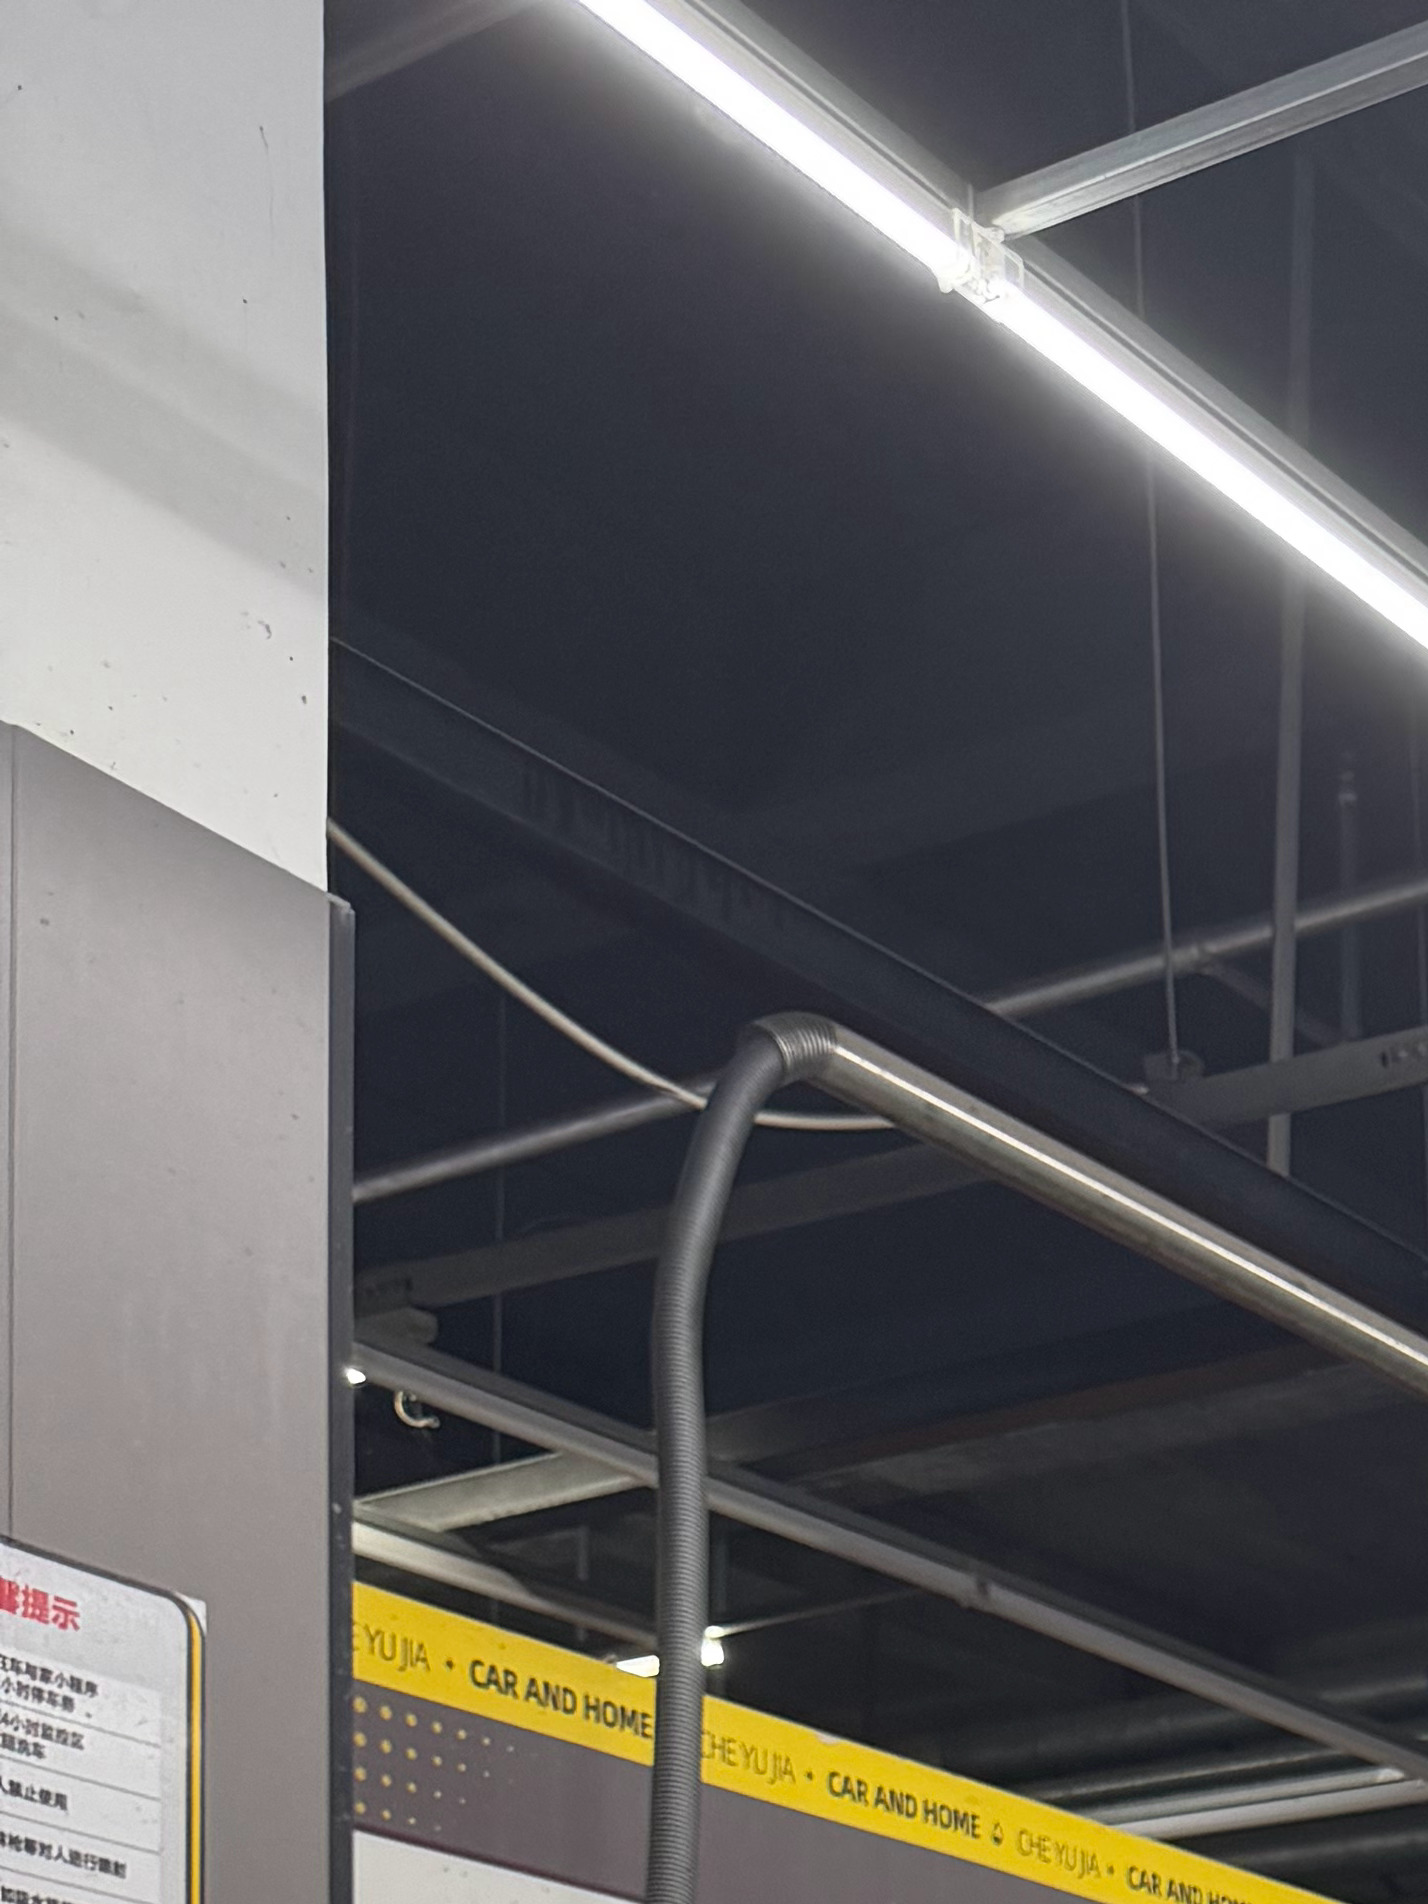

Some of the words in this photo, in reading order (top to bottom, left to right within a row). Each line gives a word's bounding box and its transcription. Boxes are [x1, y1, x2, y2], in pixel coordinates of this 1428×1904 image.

[468, 1659, 518, 1699] CAR
[524, 1677, 577, 1715] AND
[582, 1694, 652, 1739] HOME
[827, 1771, 869, 1806] CAR
[874, 1786, 918, 1819] AND
[923, 1799, 981, 1839] HOME
[1126, 1865, 1161, 1897] CAR
